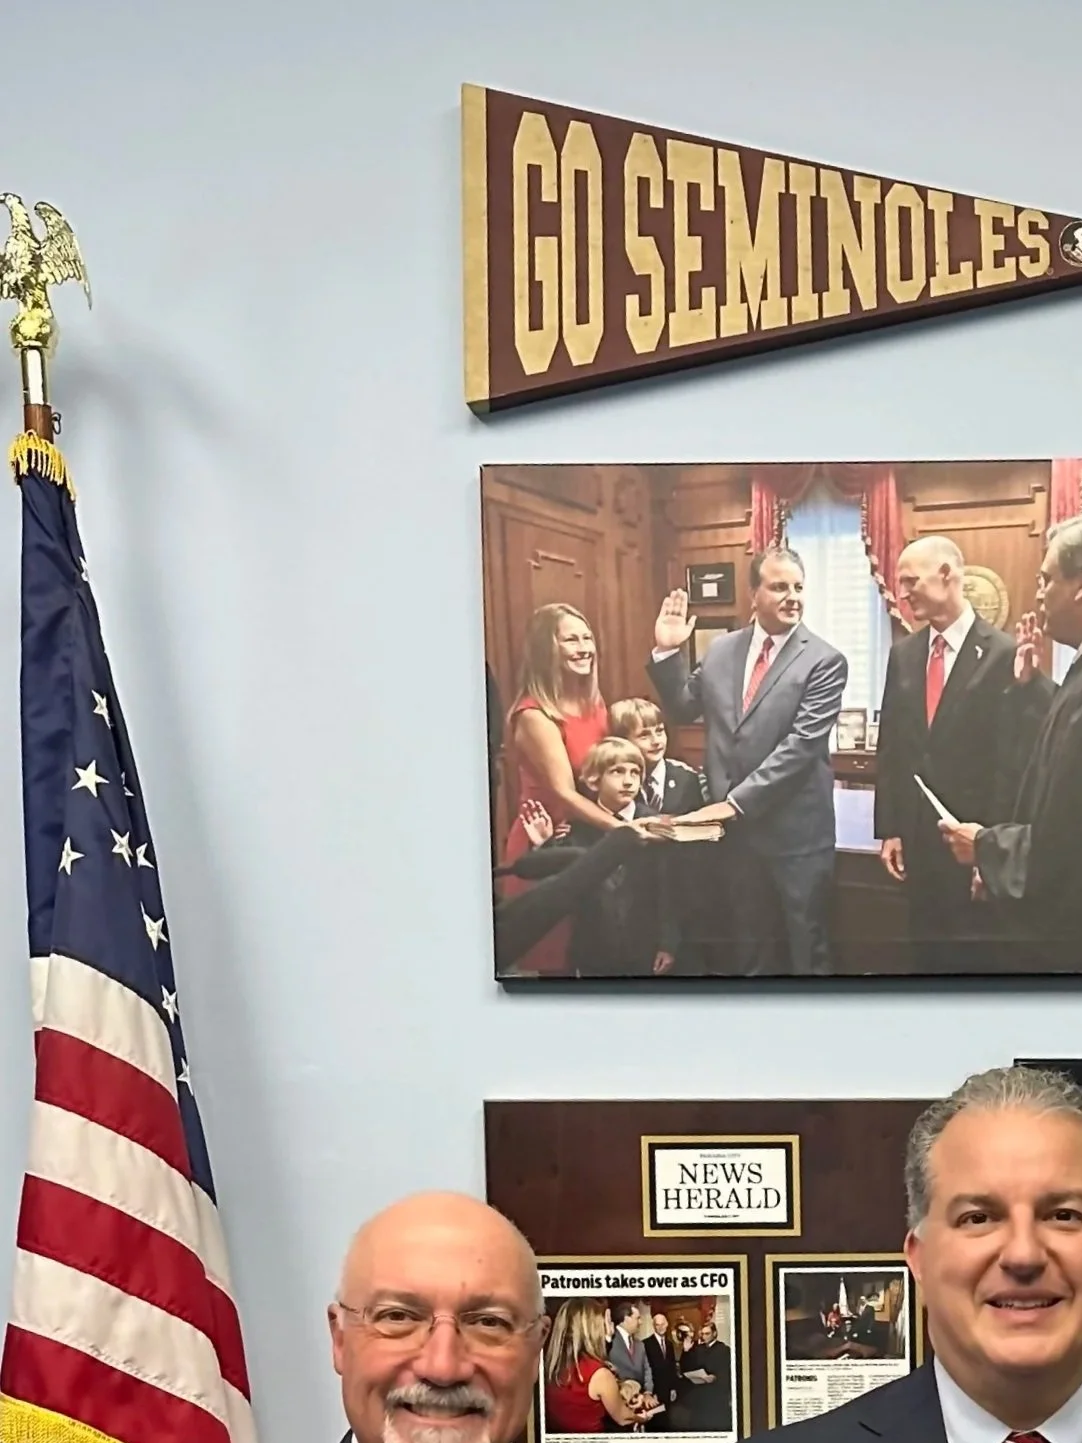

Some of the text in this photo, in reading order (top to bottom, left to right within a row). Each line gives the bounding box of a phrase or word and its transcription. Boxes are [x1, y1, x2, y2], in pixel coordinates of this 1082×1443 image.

[513, 111, 1050, 375] GO SEMINOLES
[678, 1162, 763, 1184] NEWS
[662, 1187, 781, 1210] HERALD
[541, 1273, 728, 1289] Patronis takes over as CFO
